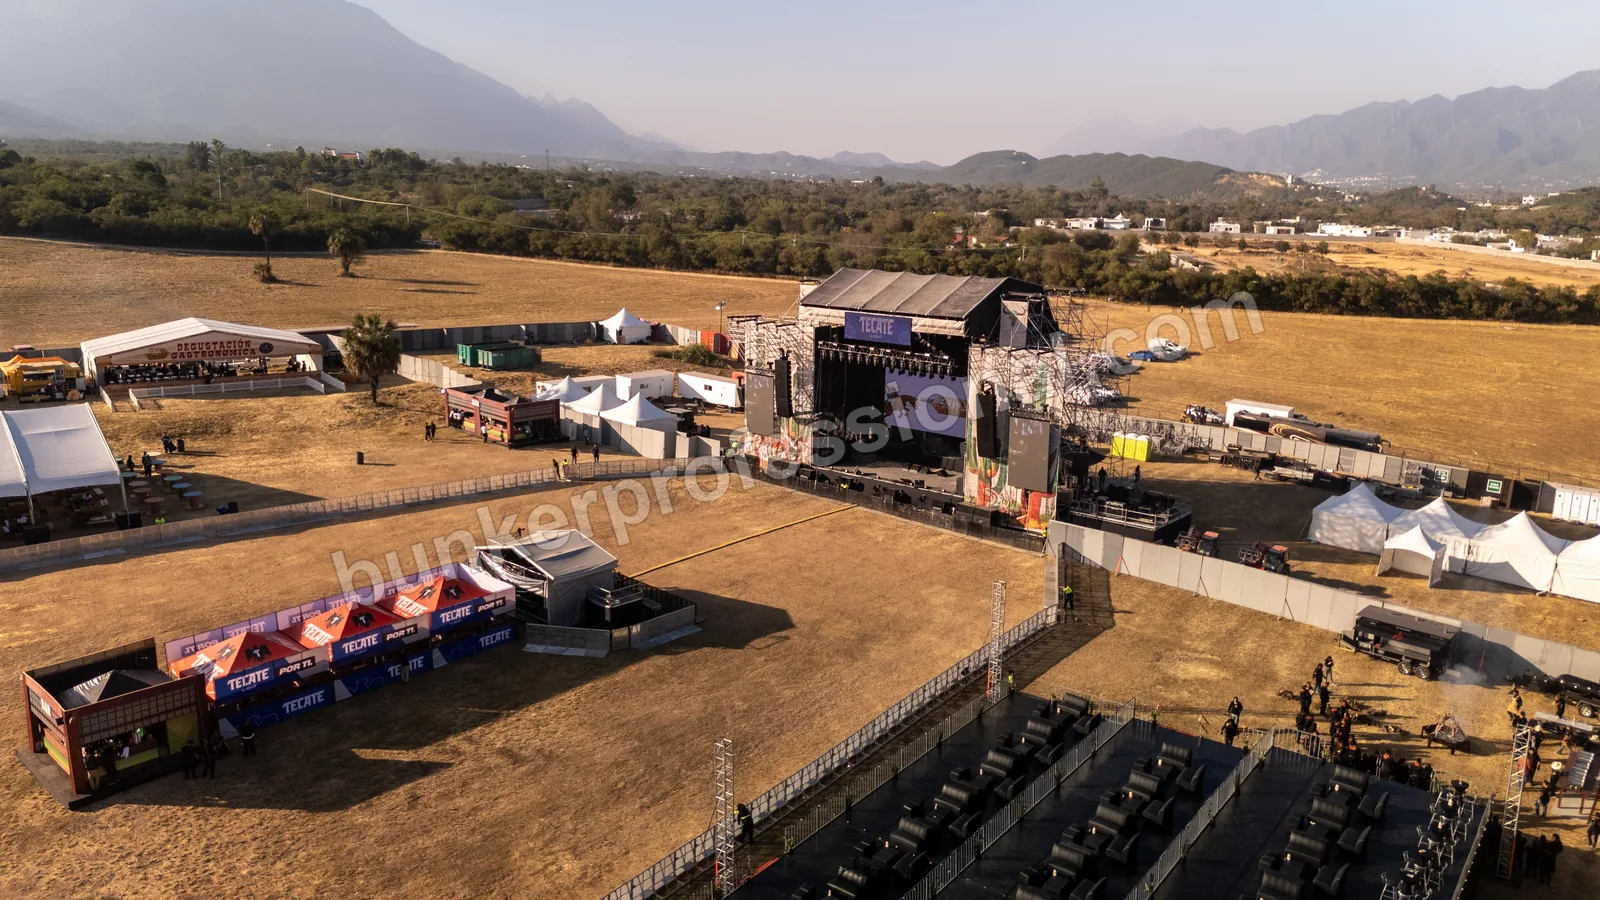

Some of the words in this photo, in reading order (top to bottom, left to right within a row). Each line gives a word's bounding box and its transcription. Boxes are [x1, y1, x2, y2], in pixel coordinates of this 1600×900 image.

[859, 316, 894, 335] TECATE
[177, 338, 251, 352] DEGUSTACIÓN
[395, 595, 429, 616] TECATE
[440, 605, 472, 623] TECATE
[478, 602, 494, 613] POR
[302, 622, 335, 646] TECATE
[342, 633, 379, 654] TECATE
[386, 630, 404, 641] POR
[479, 628, 512, 648] TECATE
[279, 662, 300, 676] POR
[388, 656, 425, 678] TETE
[227, 668, 271, 691] TECATE
[282, 690, 325, 714] TECATE
